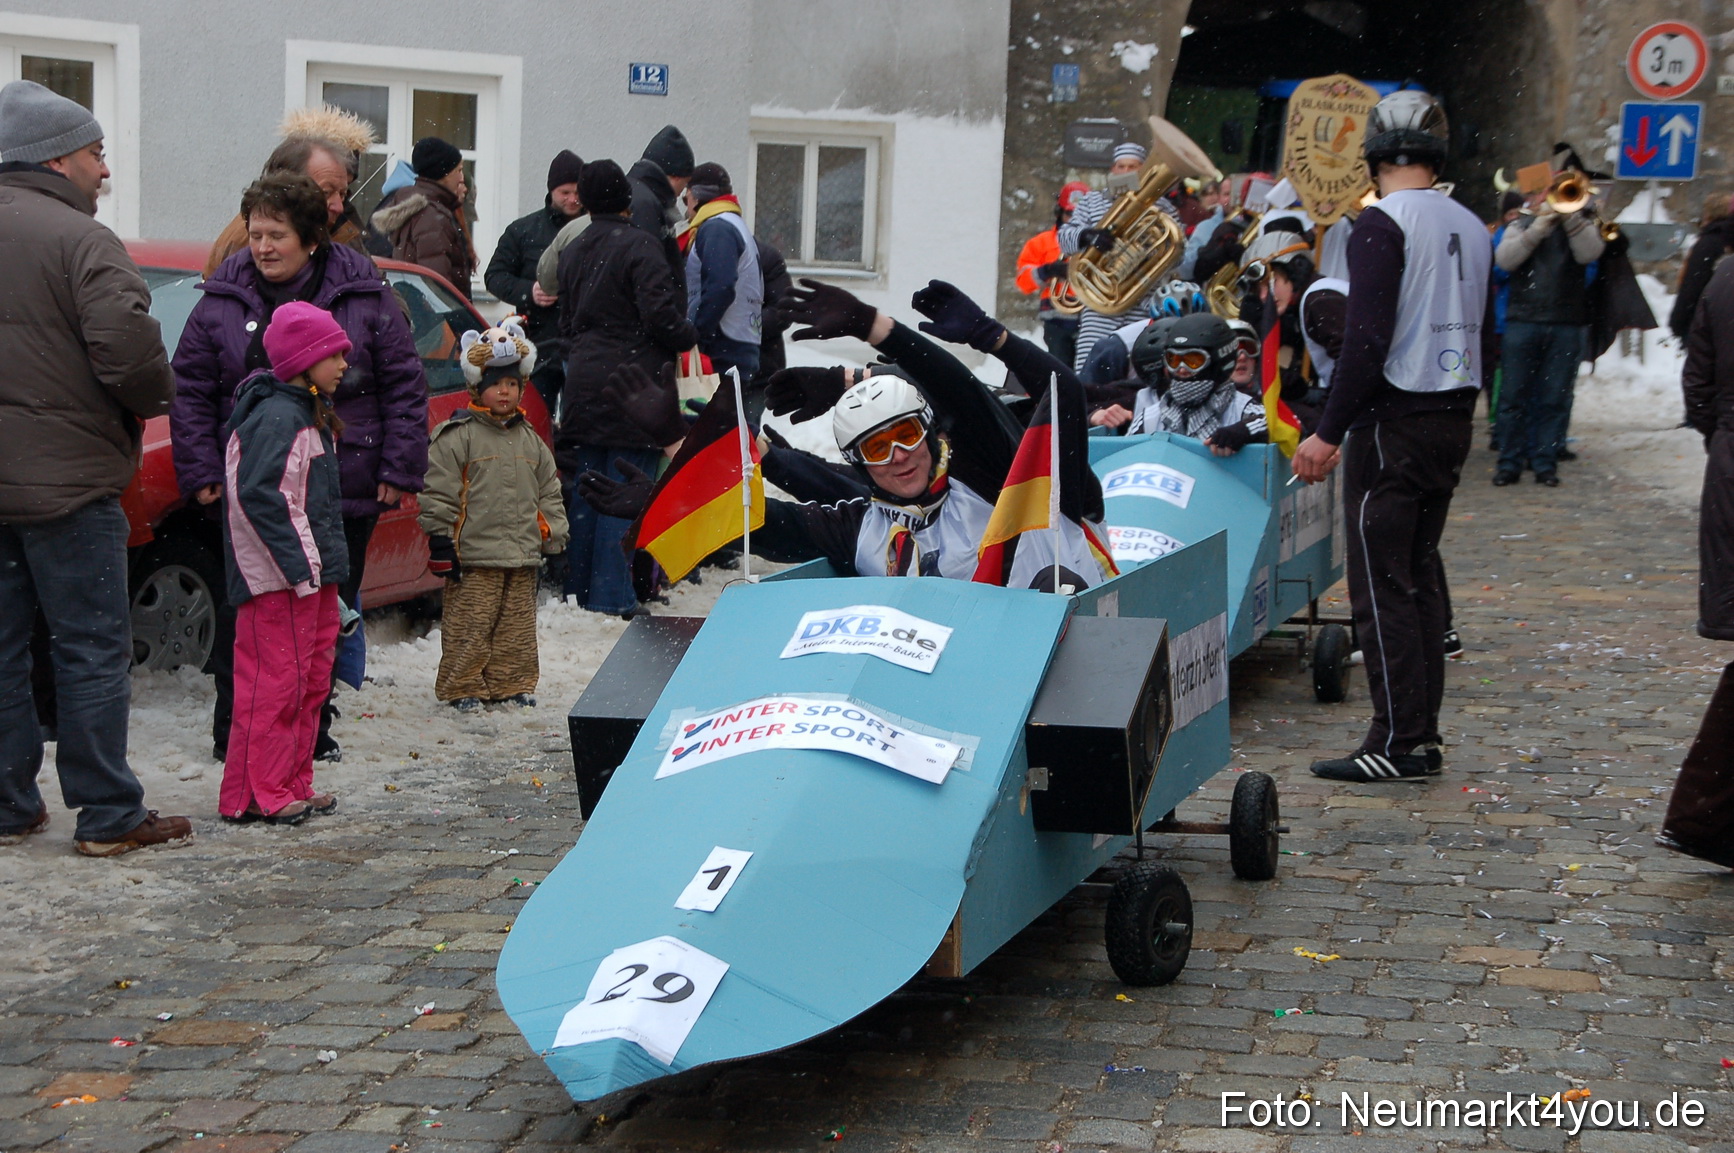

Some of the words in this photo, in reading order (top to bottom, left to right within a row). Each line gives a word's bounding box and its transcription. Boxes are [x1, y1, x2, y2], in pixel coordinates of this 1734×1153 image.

[638, 65, 661, 83] 12
[1651, 46, 1664, 73] 3
[1668, 60, 1683, 74] m
[1447, 233, 1464, 281] 1
[1106, 472, 1185, 494] DKB
[800, 616, 937, 652] DKB.de
[702, 865, 732, 891] 1
[590, 963, 695, 1004] 29
